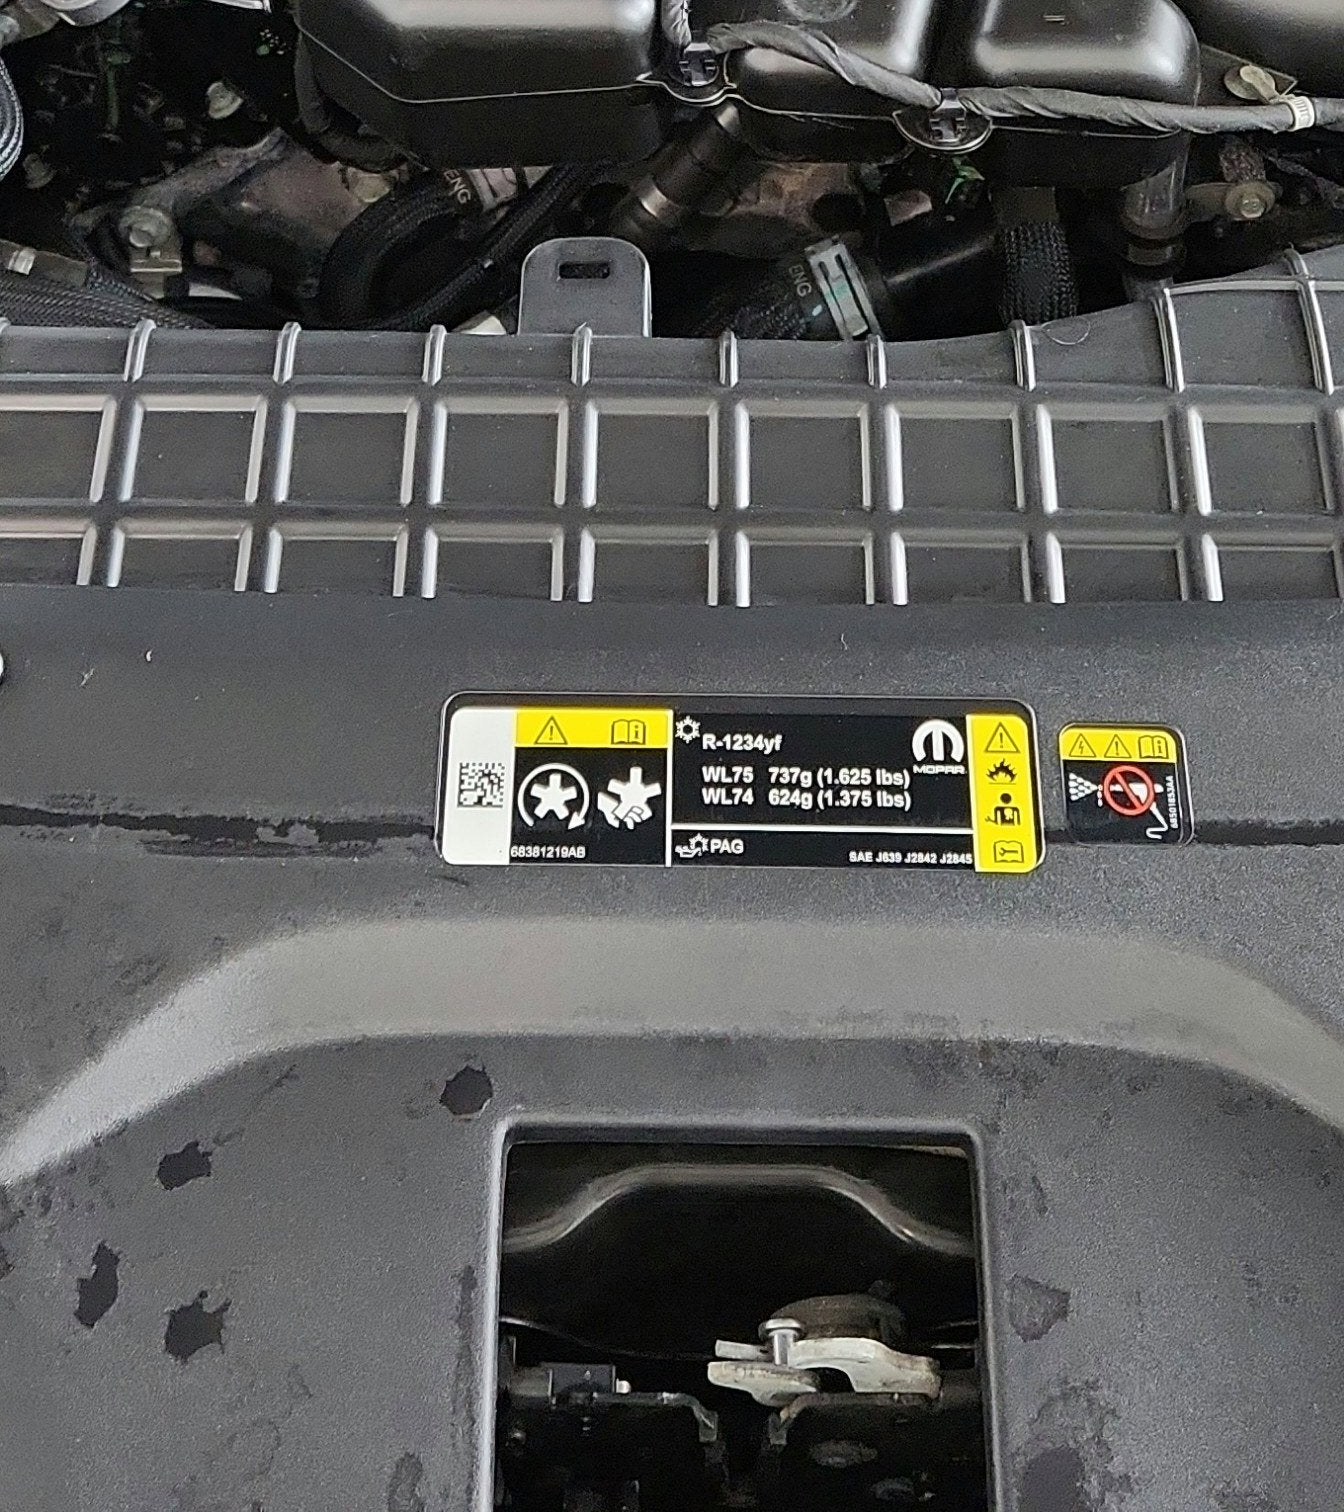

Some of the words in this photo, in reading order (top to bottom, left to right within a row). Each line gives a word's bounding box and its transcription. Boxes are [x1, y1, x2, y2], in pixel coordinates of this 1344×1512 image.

[443, 169, 472, 204] ENG
[788, 264, 812, 297] ENG
[702, 733, 783, 755] R-1234yf
[701, 765, 754, 784] WL75
[768, 766, 813, 788] 737g
[816, 767, 873, 789] (1.625
[875, 767, 911, 790] lbs)
[912, 764, 967, 775] MOPAR
[701, 787, 754, 806] WL74
[768, 788, 814, 810] 624g
[816, 789, 873, 811] (1.375
[876, 790, 912, 812] lbs)
[510, 845, 586, 859] 68381219AB
[710, 838, 744, 855] PAG
[848, 850, 874, 863] SAE
[875, 851, 903, 864] J639
[904, 851, 938, 865] J2842
[939, 852, 973, 865] J2845
